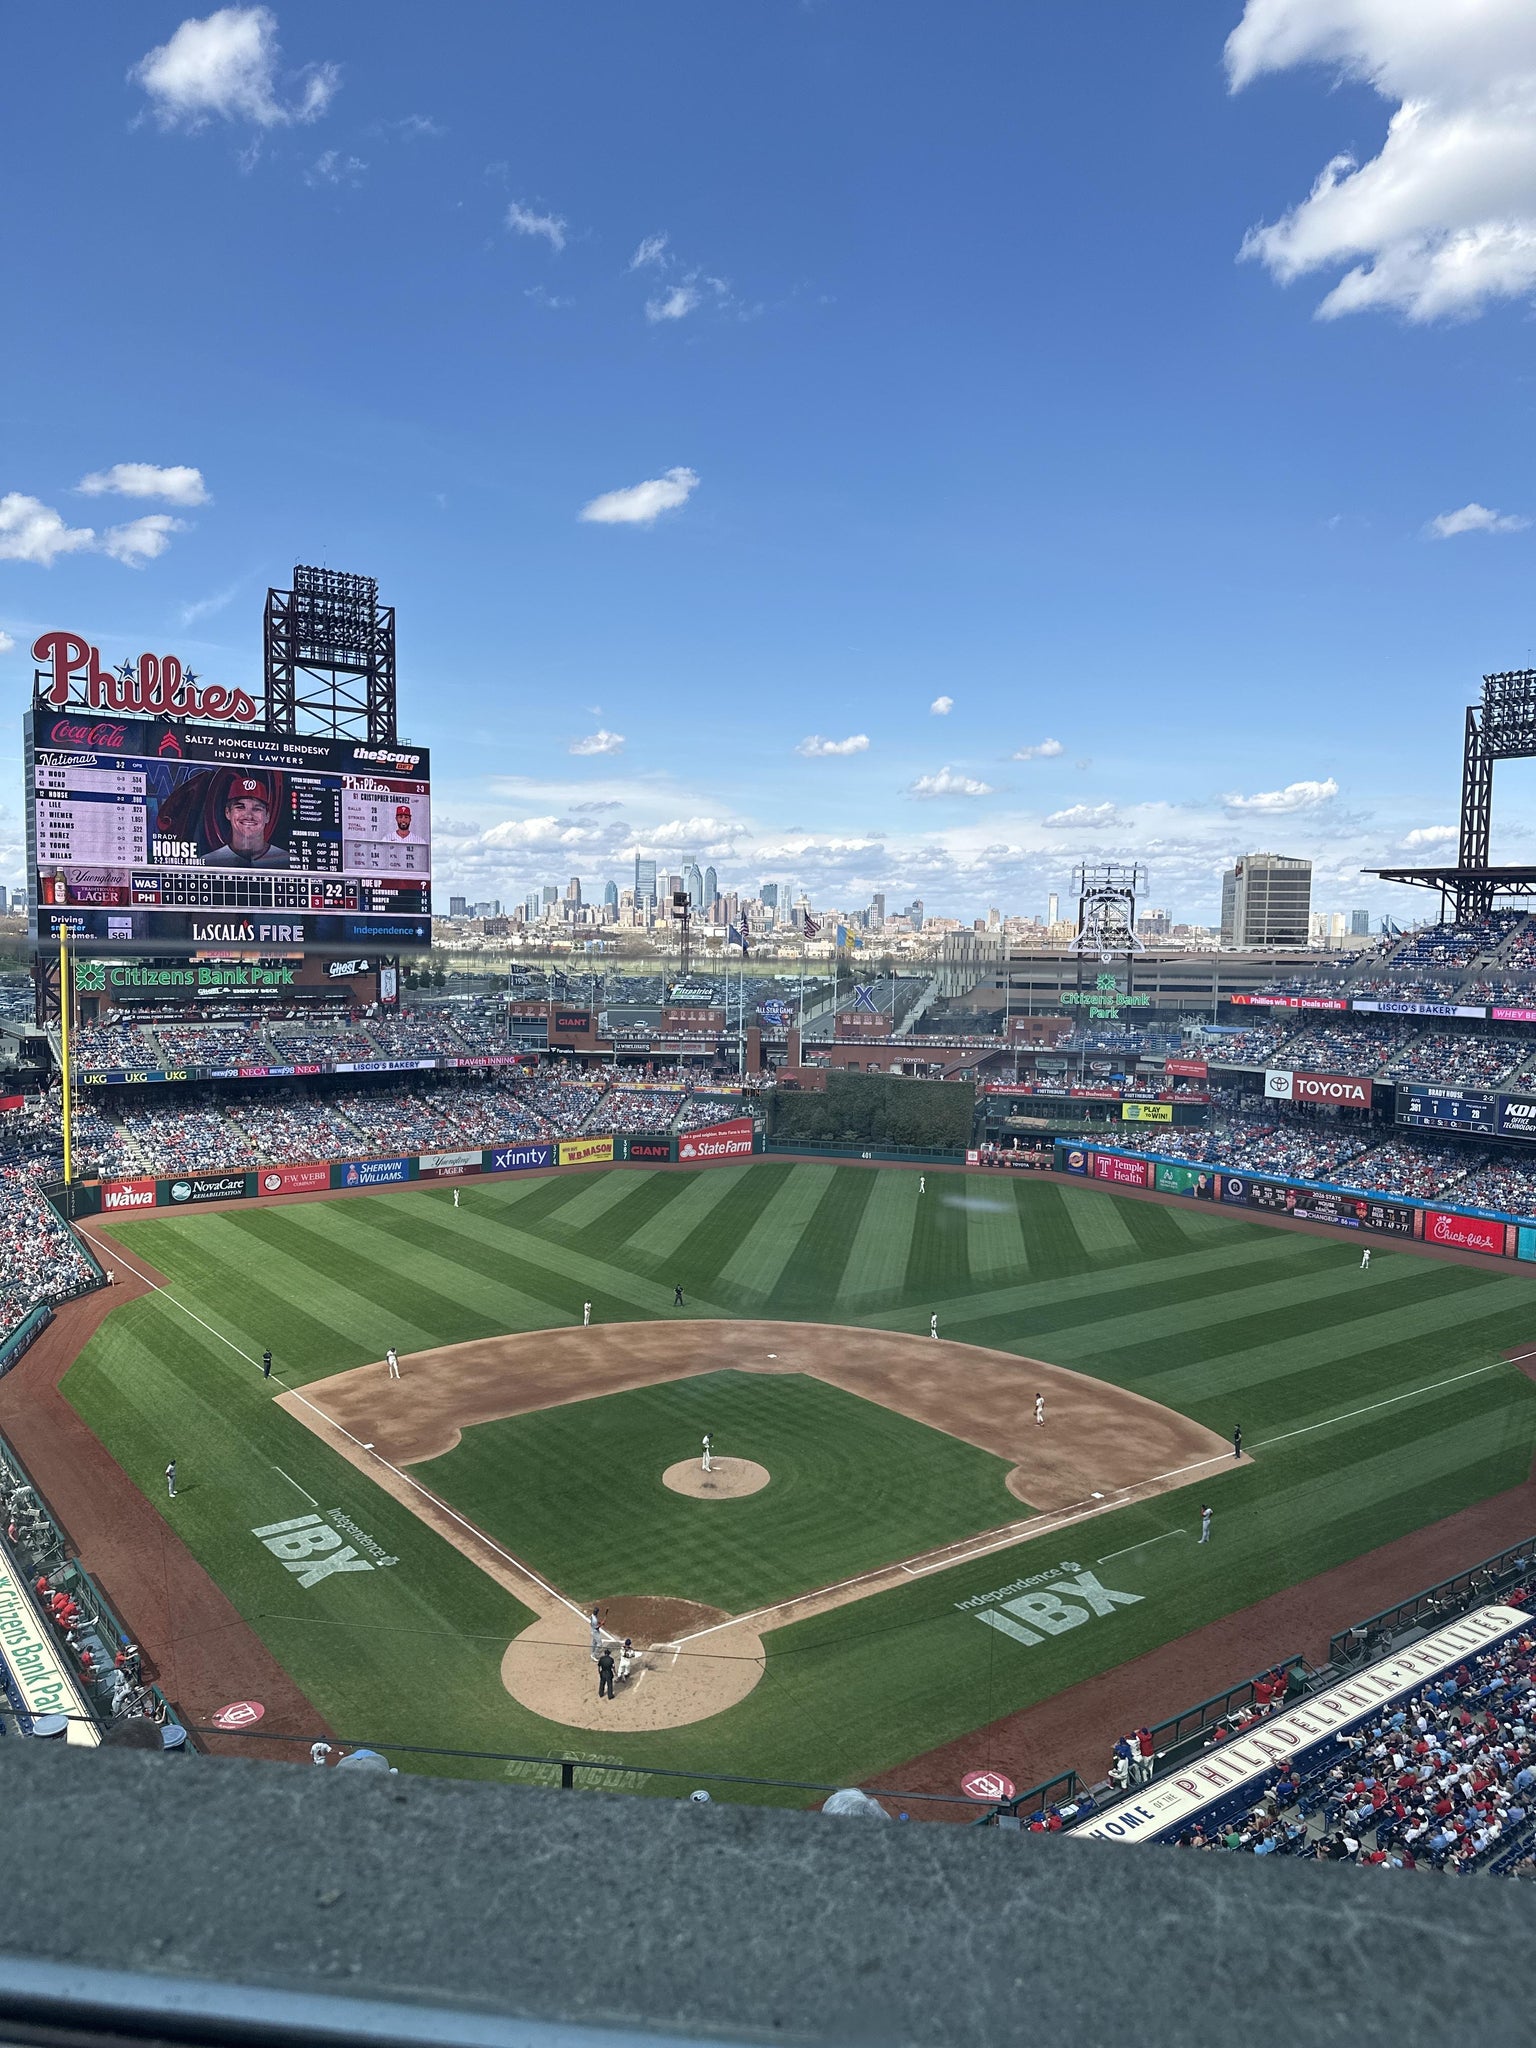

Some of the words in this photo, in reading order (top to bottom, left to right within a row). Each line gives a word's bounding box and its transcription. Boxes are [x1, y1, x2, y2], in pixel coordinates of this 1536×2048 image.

[32, 631, 257, 723] Phillies
[185, 734, 214, 745] SALTZ
[218, 738, 279, 751] MONGELUZZI
[283, 743, 330, 756] BENDESKY
[39, 753, 97, 767] Nationals
[215, 750, 251, 760] INJURY
[259, 754, 303, 765] LAWYERS
[353, 747, 420, 764] theScore
[342, 776, 391, 792] Phillies
[360, 793, 390, 802] CRISTOPHER
[152, 840, 198, 858] HOUSE
[71, 869, 124, 884] Yuengling
[135, 880, 158, 888] WAS
[362, 879, 373, 887] DUE
[374, 880, 382, 888] UP
[77, 892, 119, 902] LAGER
[326, 884, 343, 897] 2-2
[138, 894, 155, 902] PHI
[51, 916, 84, 924] Driving
[260, 926, 304, 942] FIRE
[353, 926, 414, 936] Independence
[330, 960, 361, 978] GHOST
[110, 966, 194, 986] Citizens
[198, 966, 248, 986] Bank
[252, 966, 294, 986] Park
[672, 984, 714, 995] Fitzpatrick
[1060, 992, 1114, 1005] Citizens
[1116, 993, 1150, 1006] Bank
[1250, 997, 1274, 1005] Phillies
[1090, 1006, 1119, 1018] Park
[1378, 1002, 1416, 1012] LISCIO'S
[1419, 1004, 1457, 1015] BAKERY
[1496, 1010, 1523, 1019] WHEY
[389, 1061, 419, 1070] BAKERY
[460, 1058, 486, 1066] RAV4th
[488, 1056, 515, 1065] INNING
[165, 1071, 187, 1080] UKG
[296, 1066, 321, 1074] NECA
[84, 1074, 107, 1084] UKG
[126, 1073, 147, 1082] UKG
[1296, 1078, 1365, 1100] TOYOTA
[1428, 1088, 1446, 1098] BRADY
[1446, 1091, 1464, 1100] HOUSE
[1433, 1106, 1437, 1114] 1
[1452, 1108, 1458, 1116] 3
[1502, 1122, 1536, 1132] TECHNOLOGY
[1511, 1117, 1530, 1125] OFFICE
[632, 1146, 670, 1156] GIANT
[360, 1157, 402, 1169] SHERWIN
[431, 1154, 470, 1167] Yuengling
[496, 1150, 548, 1168] xfinity
[1114, 1158, 1144, 1173] Temple
[300, 1172, 326, 1182] WEBB
[438, 1166, 464, 1176] LAGER
[1114, 1170, 1142, 1184] Health
[102, 1176, 142, 1184] ASPLUNDH
[192, 1178, 244, 1193] NovaCare
[104, 1191, 154, 1208] Wawa
[192, 1189, 242, 1200] REHABILITATION
[1308, 1212, 1339, 1223] CHANGEUP
[1434, 1217, 1494, 1249] Chick-fil-A
[326, 1507, 386, 1557] Independence
[251, 1513, 375, 1589] IBX
[953, 1567, 1063, 1611] Independence
[974, 1570, 1146, 1647] IBX
[0, 1590, 31, 1644] Citizens
[11, 1642, 58, 1686] Bank
[1088, 1805, 1154, 1841] HOME
[1172, 1673, 1400, 1800] PHILADELPHIA
[1392, 1610, 1513, 1676] PHILLIES
